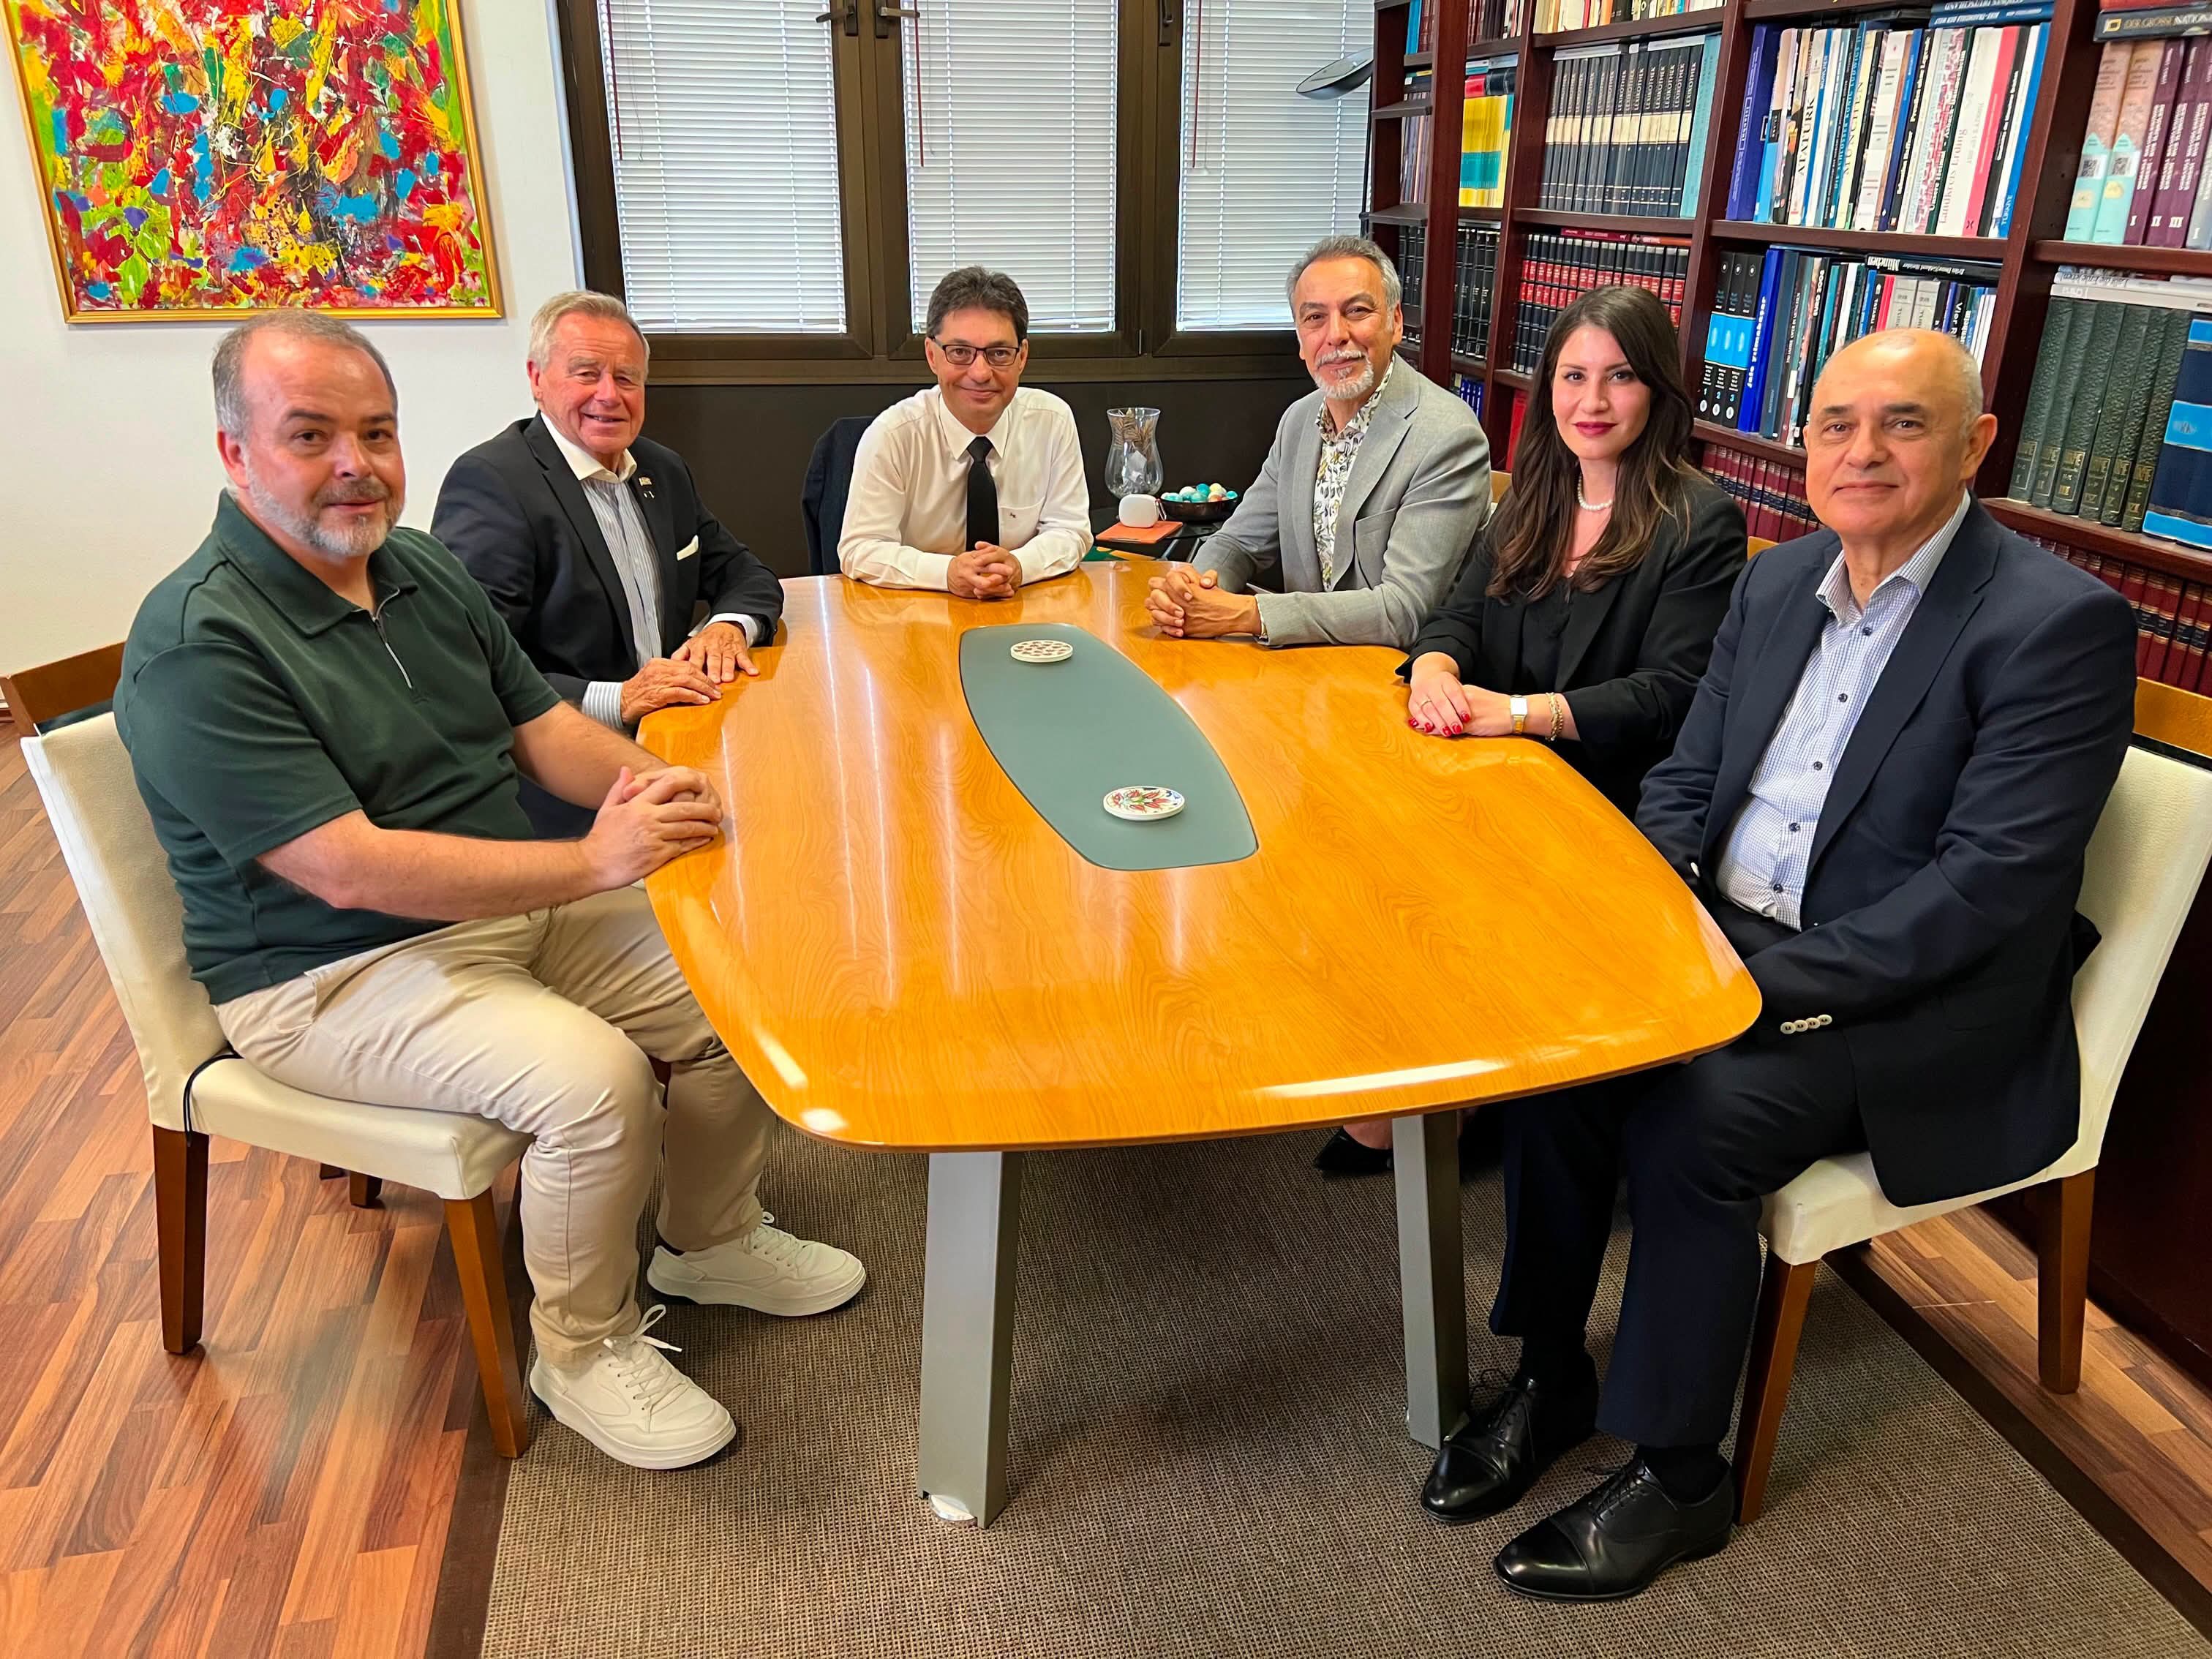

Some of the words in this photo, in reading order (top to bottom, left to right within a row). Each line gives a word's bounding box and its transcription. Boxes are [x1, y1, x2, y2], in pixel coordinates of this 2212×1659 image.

[1685, 61, 1696, 108] LEXIKOTHEK
[1903, 129, 1914, 160] Haffner
[1940, 169, 1957, 224] Landkreis
[1951, 128, 1968, 167] Erding
[2169, 216, 2184, 227] III
[1867, 256, 1900, 271] München
[1813, 294, 1821, 317] EURO
[1817, 269, 1825, 293] 2008
[1953, 302, 1963, 325] Vier
